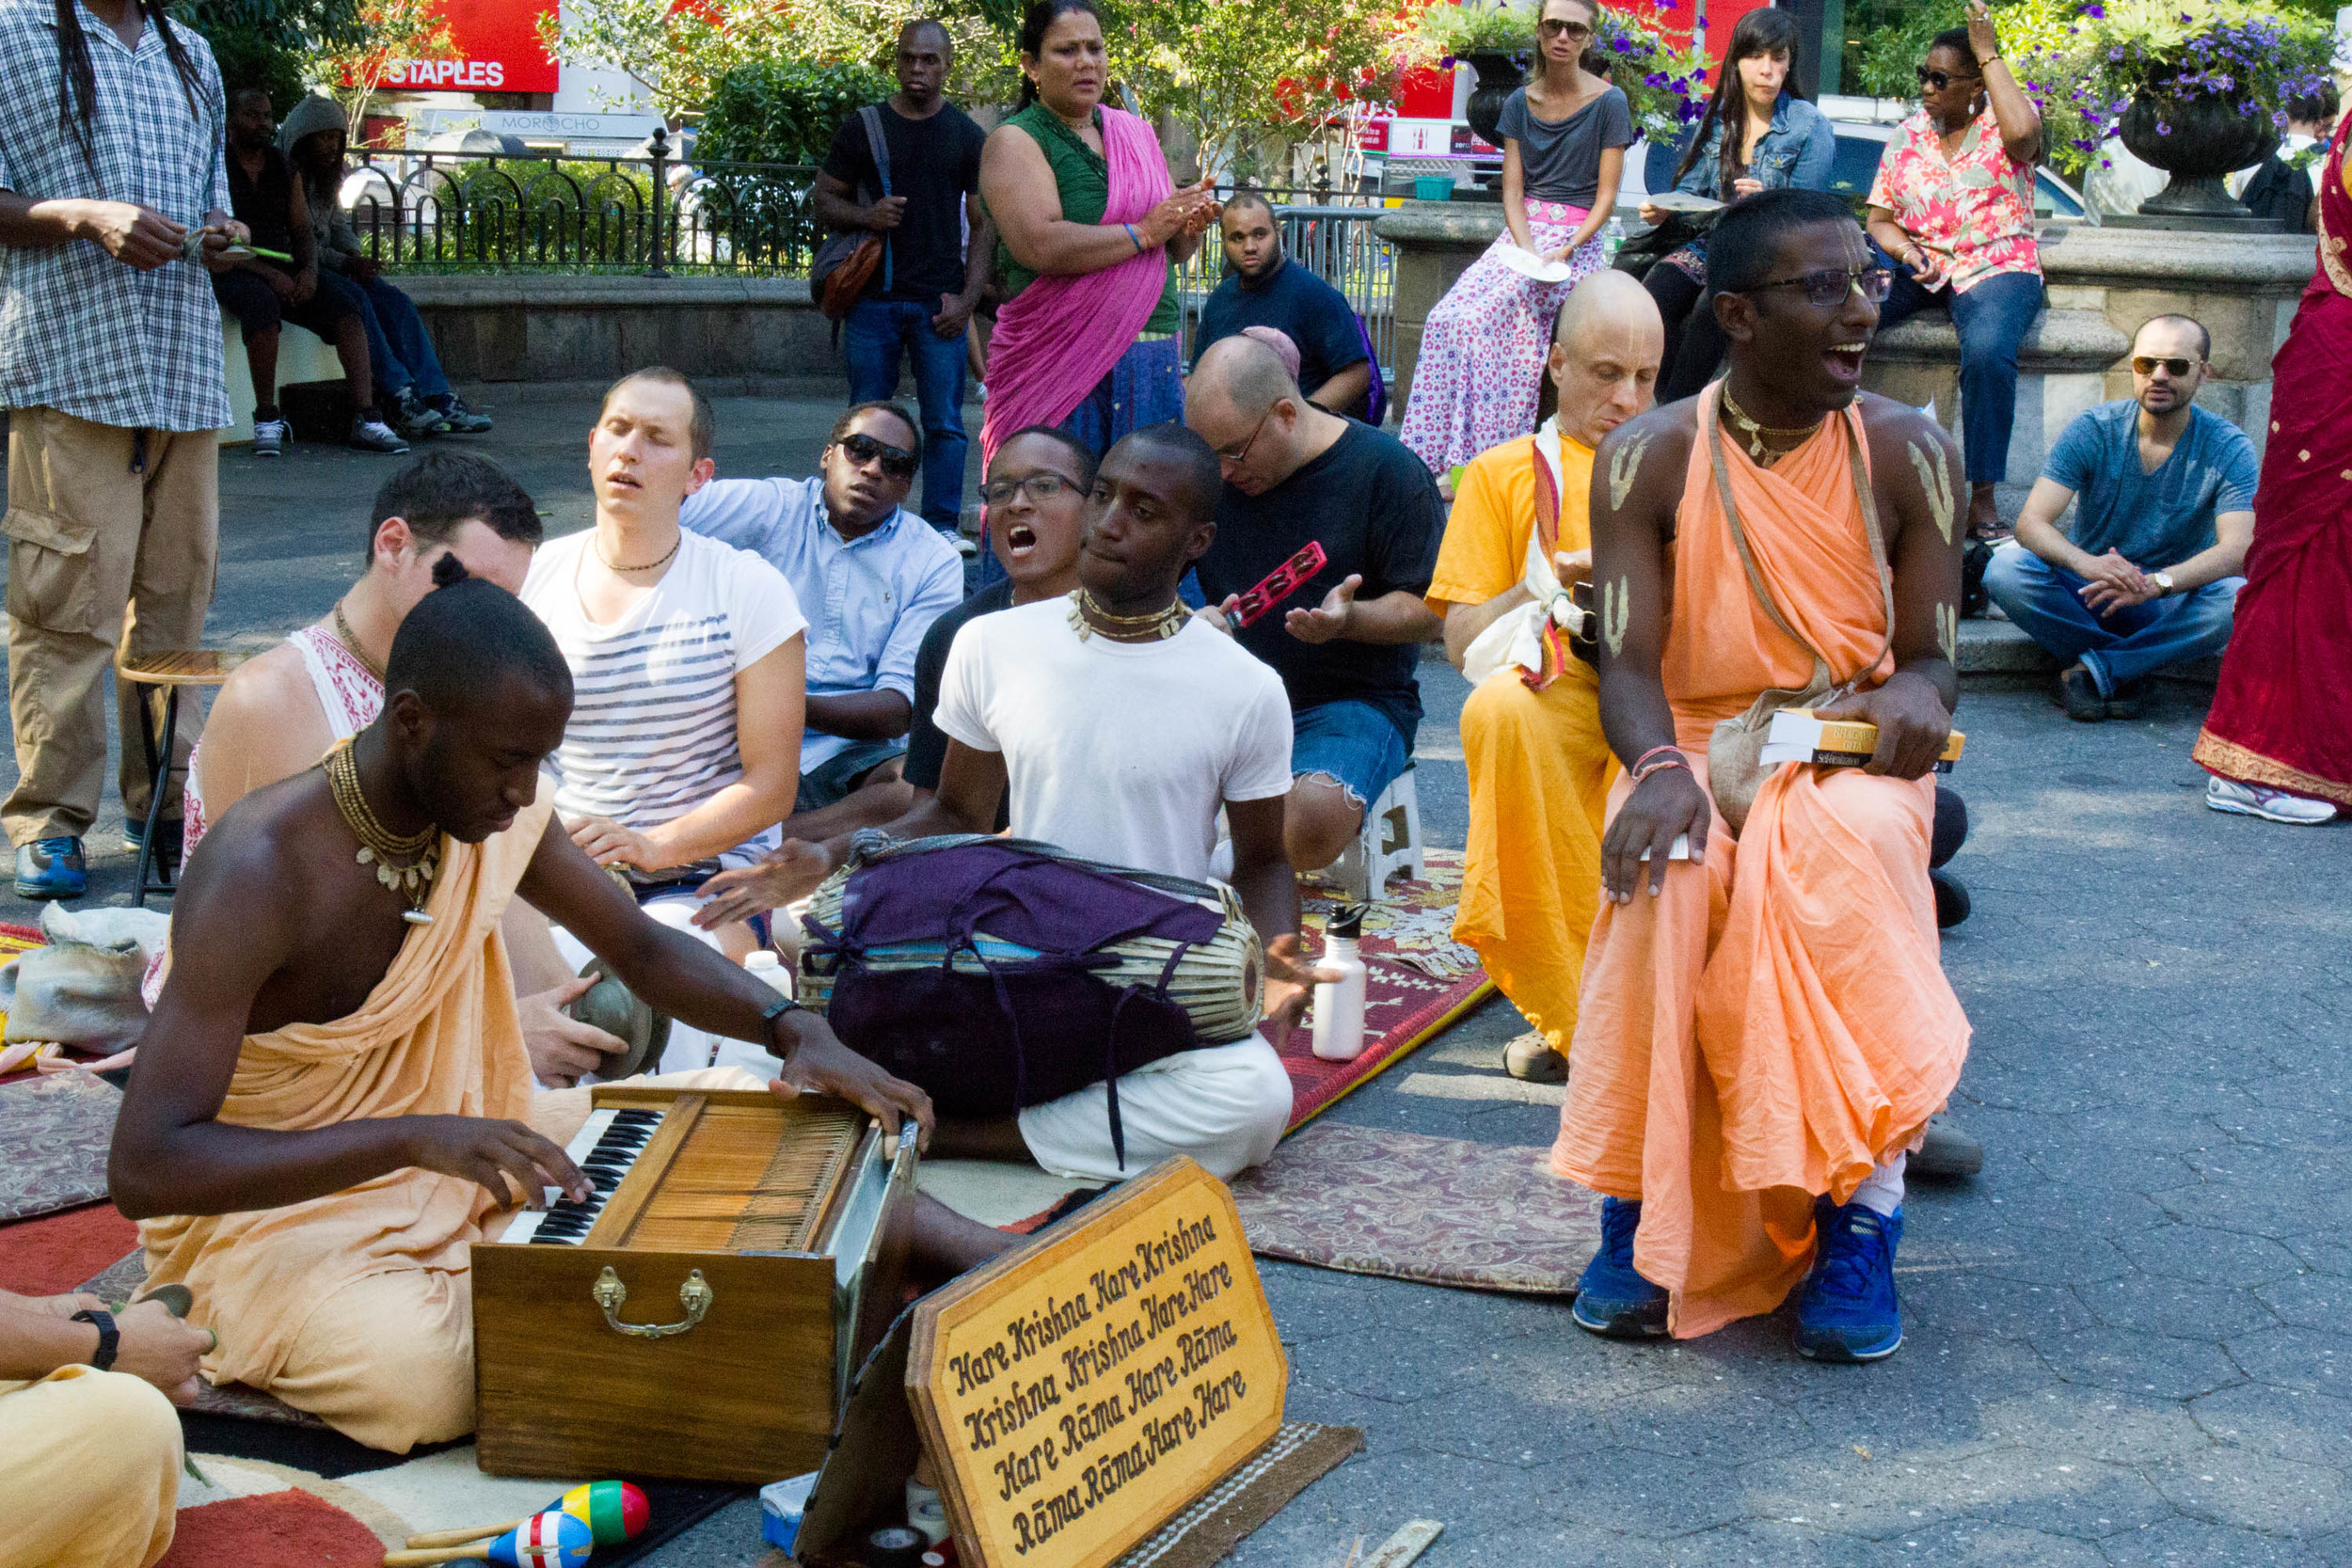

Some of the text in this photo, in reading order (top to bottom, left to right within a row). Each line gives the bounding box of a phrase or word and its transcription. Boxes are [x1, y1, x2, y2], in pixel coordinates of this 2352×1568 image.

[388, 58, 504, 87] STAPLES
[502, 116, 600, 132] MOROCHO
[949, 1214, 1216, 1397] Hare Krishna Hare Krishna
[963, 1261, 1232, 1451] Krishna Krishna Hare Hare
[994, 1320, 1237, 1501] Hare Rāma Hare Rāma
[1012, 1370, 1247, 1556] Rāma Rāma Hare Hare
